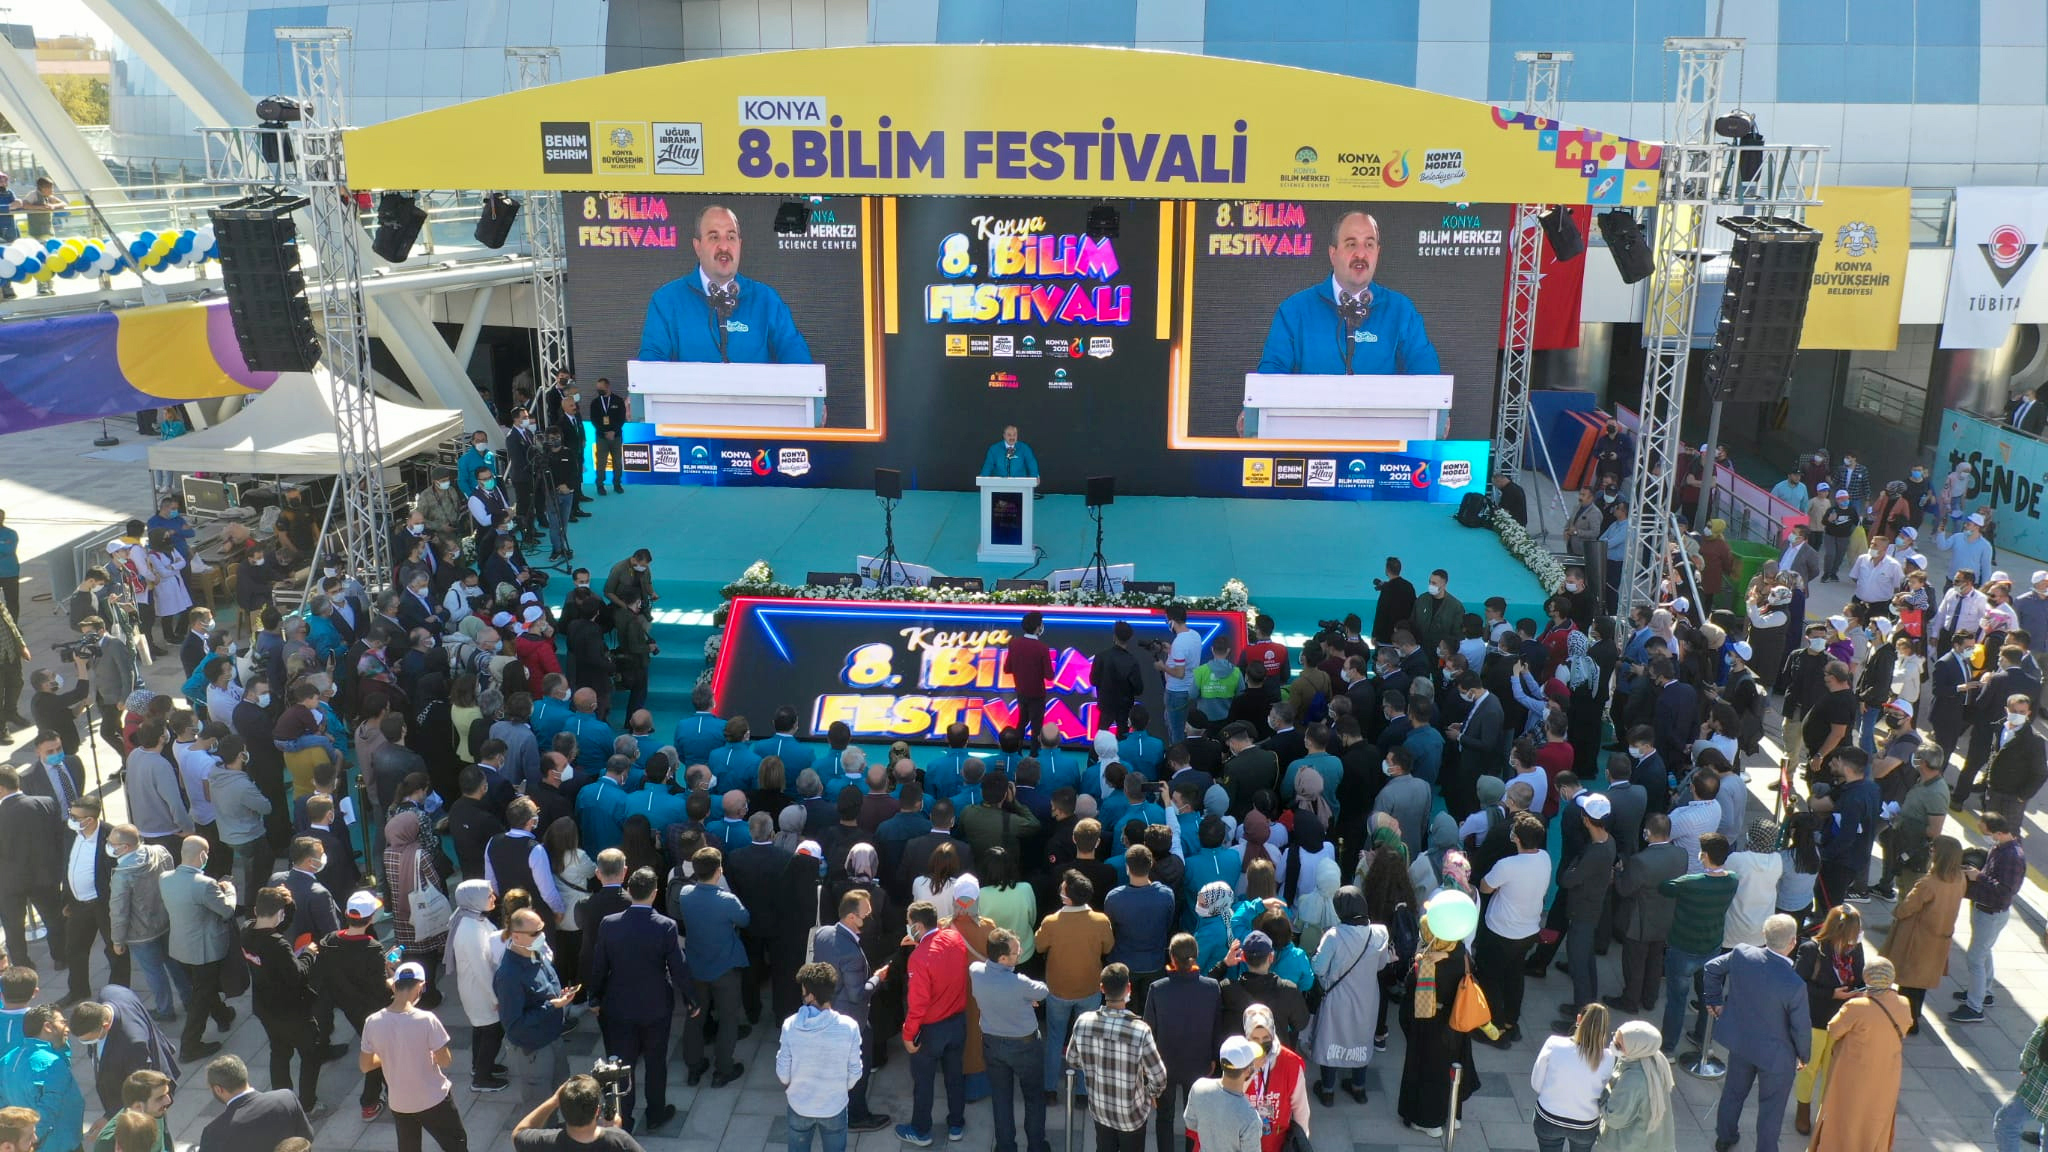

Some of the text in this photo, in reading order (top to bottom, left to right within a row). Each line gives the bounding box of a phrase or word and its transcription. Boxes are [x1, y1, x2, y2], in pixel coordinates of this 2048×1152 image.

[744, 100, 821, 121] KONYA
[665, 127, 690, 136] UĞUR
[545, 135, 587, 147] BENİM
[660, 136, 697, 144] İBRAHİM
[546, 149, 588, 161] ŞEHRİM
[657, 144, 700, 167] Altay
[964, 118, 1248, 184] FESTİVALİ
[1426, 151, 1462, 162] KONYA
[1338, 153, 1381, 164] KONYA
[1351, 166, 1380, 176] 2021
[1425, 161, 1462, 170] MODELİ
[971, 215, 1047, 241] Konya
[1441, 214, 1481, 229] KONYA
[577, 225, 679, 248] FESTİVALİ
[810, 224, 857, 238] MERKEZİ
[1418, 230, 1451, 244] BİLİM
[778, 240, 857, 250] SCIENCE CENTER
[1208, 233, 1313, 257] FESTİVALİ
[1418, 246, 1501, 256] SCIENCE CENTER
[937, 233, 1120, 282] 8. BİLİM
[1835, 262, 1872, 272] KONYA
[1813, 272, 1890, 288] BÜYÜKŞEHİR
[1827, 287, 1873, 296] BELEDİYESİ
[925, 283, 1133, 326] FESTİVALİ
[721, 450, 751, 459] KONYA
[731, 459, 752, 467] 2021
[1380, 464, 1411, 472] KONYA
[900, 626, 1013, 652] Konya
[838, 642, 902, 689] 8.
[1346, 1047, 1368, 1062] PARIS
